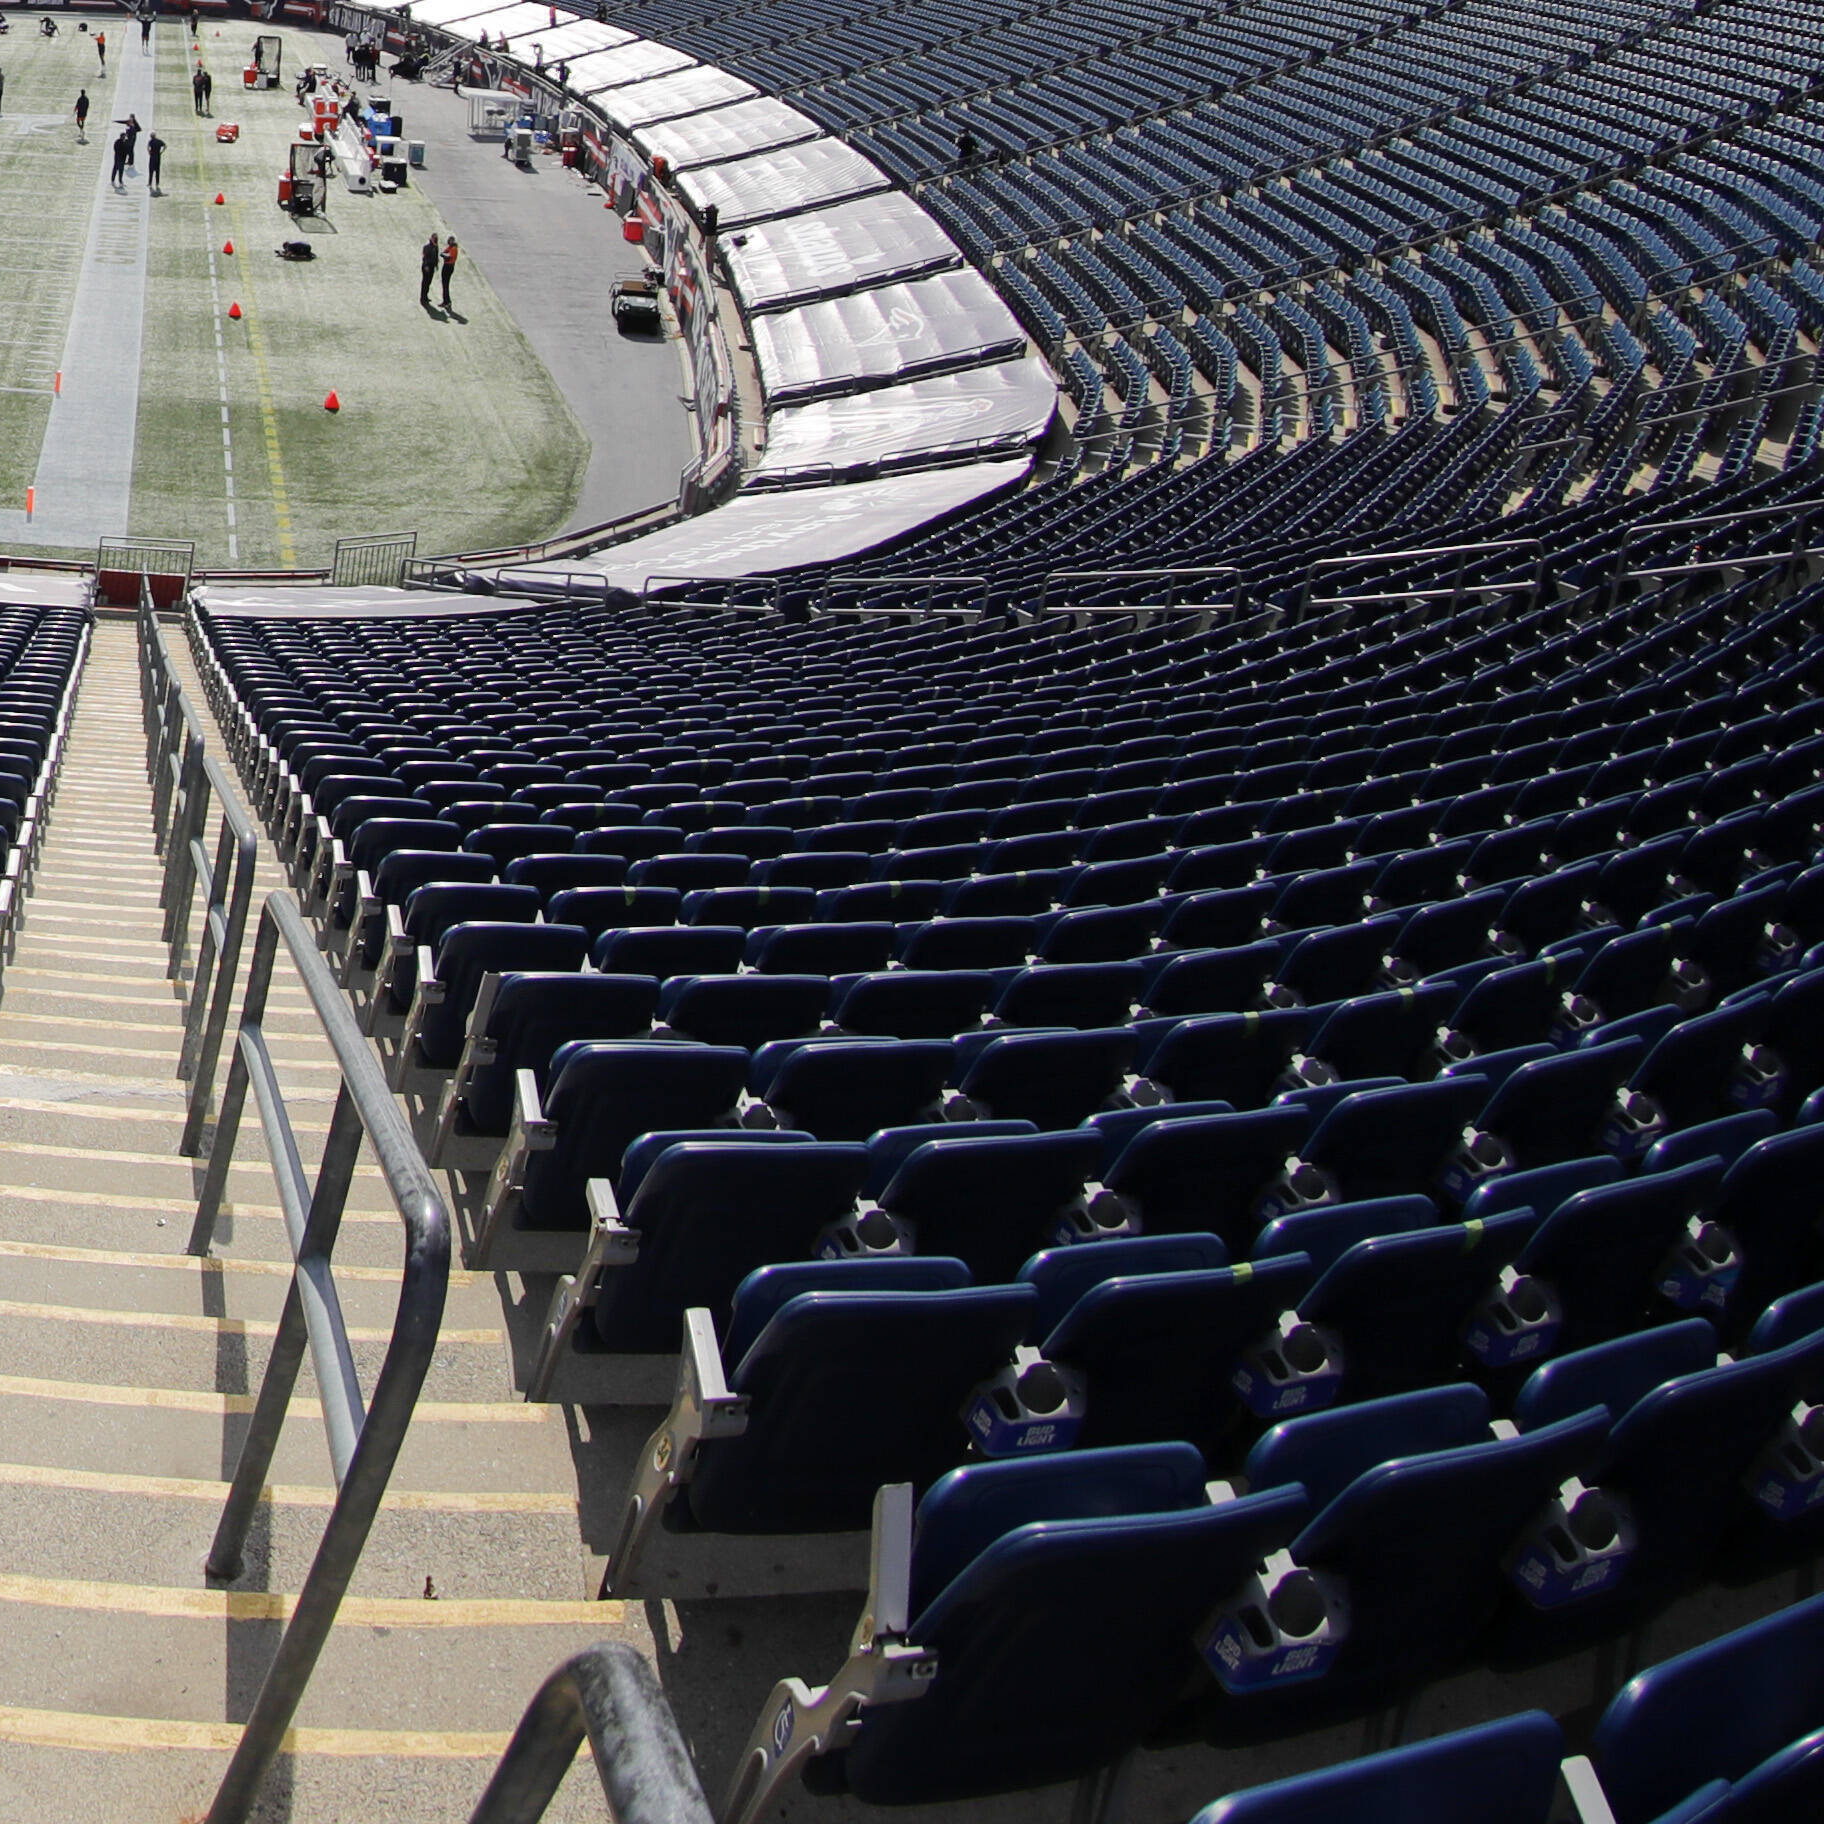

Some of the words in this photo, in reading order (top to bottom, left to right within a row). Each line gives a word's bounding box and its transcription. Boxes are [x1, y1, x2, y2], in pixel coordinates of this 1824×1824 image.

[1027, 1424, 1055, 1438] BUD
[1016, 1433, 1056, 1448] LIGHT
[1284, 1646, 1319, 1664] BUD
[1271, 1656, 1319, 1675] LIGHT
